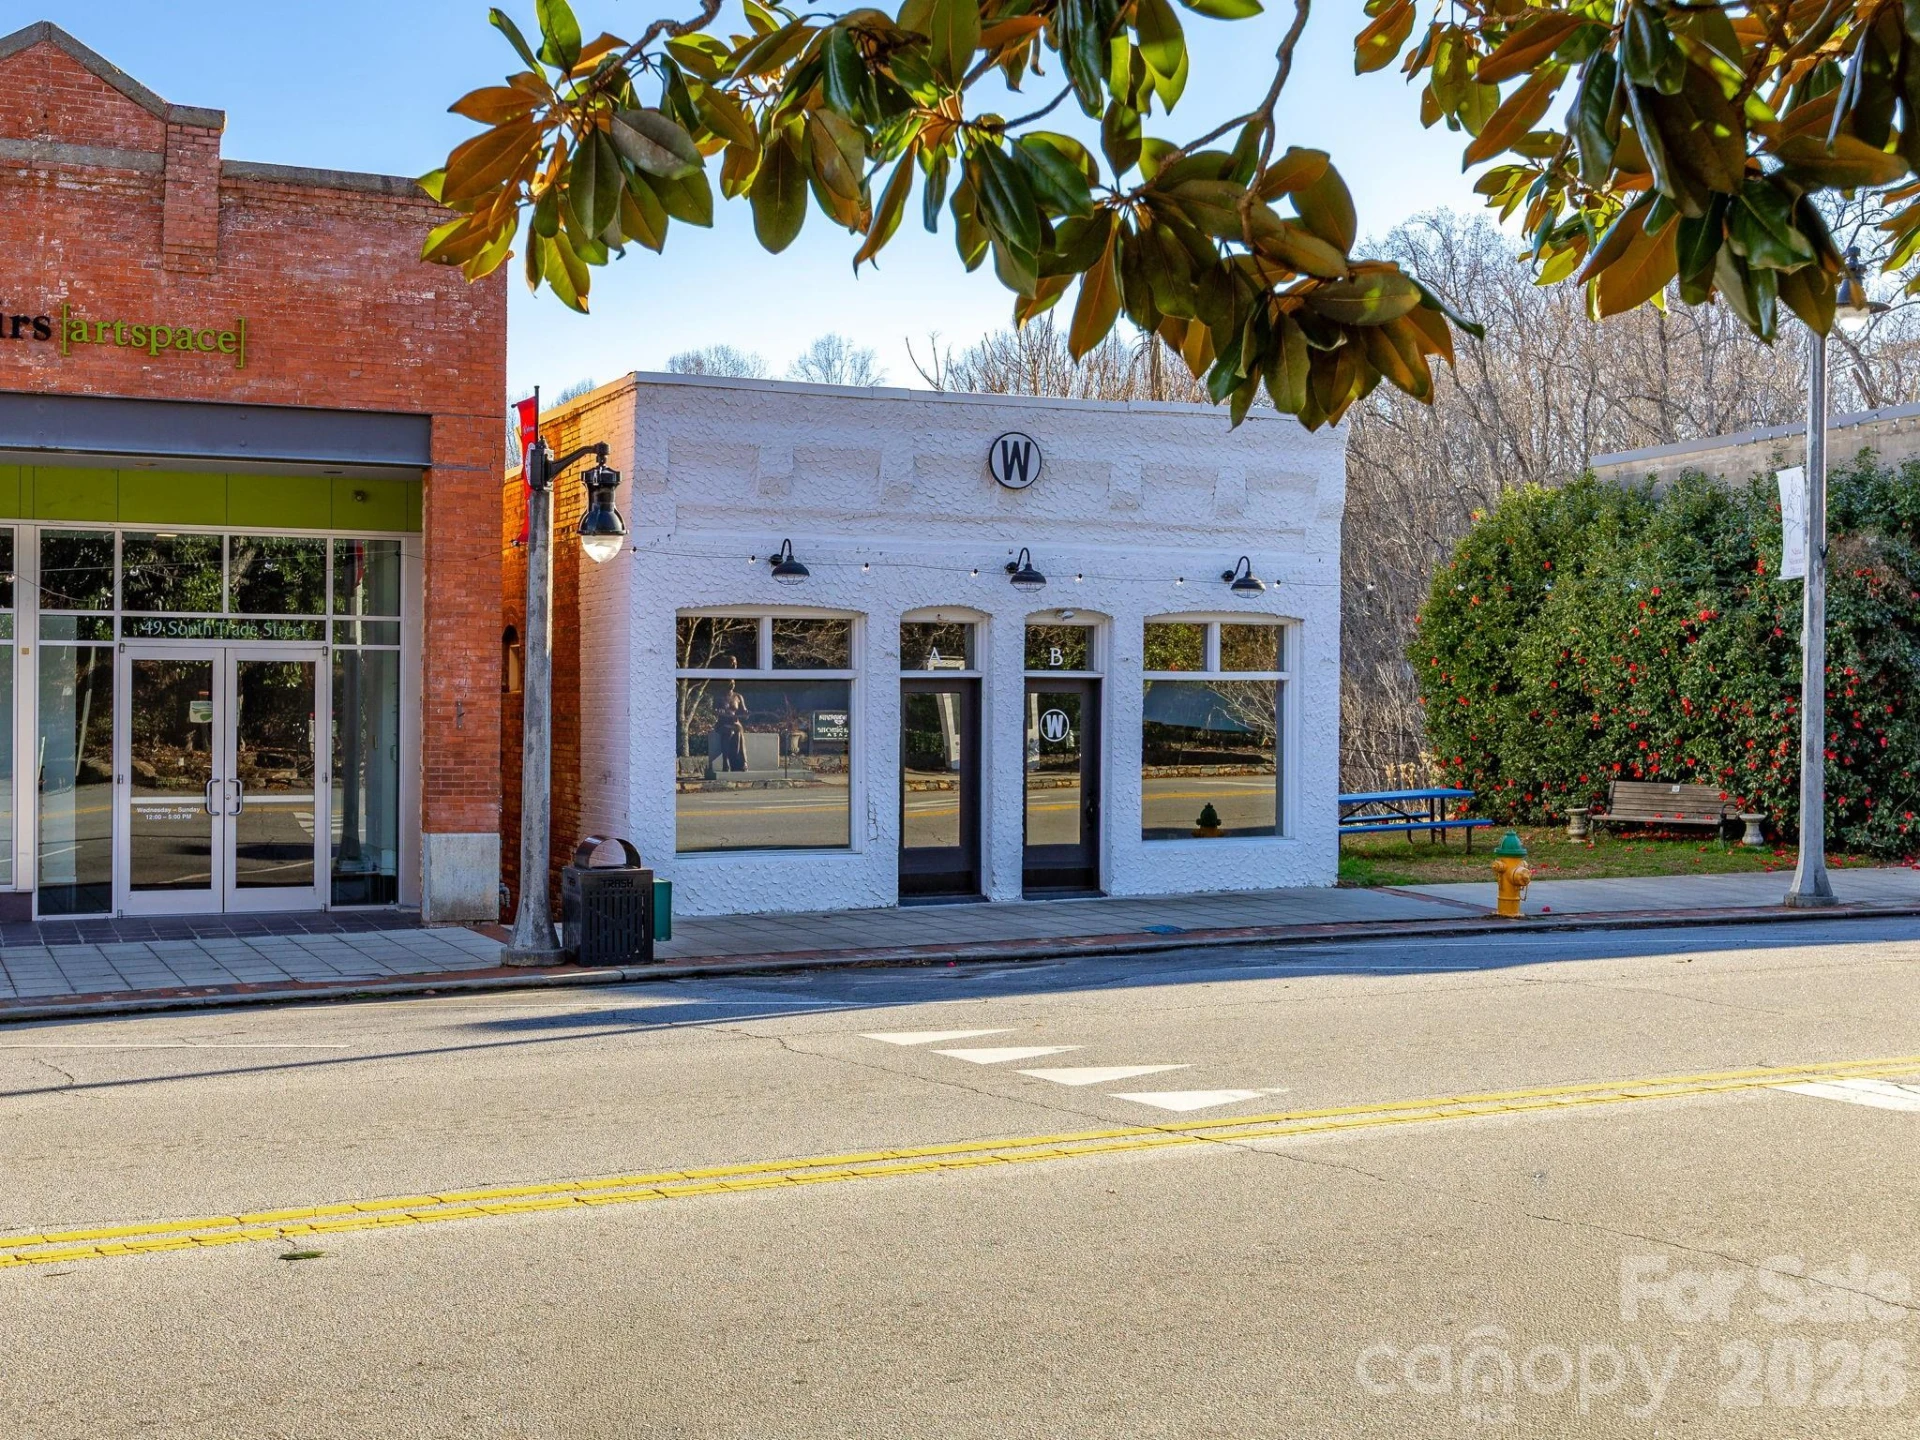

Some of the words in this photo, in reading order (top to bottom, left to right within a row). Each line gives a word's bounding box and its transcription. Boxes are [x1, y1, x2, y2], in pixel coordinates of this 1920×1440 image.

[1001, 440, 1031, 482] W
[141, 620, 163, 636] 49
[167, 620, 212, 637] South
[215, 621, 258, 637] Trade
[263, 621, 306, 637] Street
[927, 647, 942, 666] A
[1050, 648, 1064, 666] B
[1046, 714, 1064, 738] W
[177, 806, 201, 814] Sunday
[602, 879, 634, 888] TRASH
